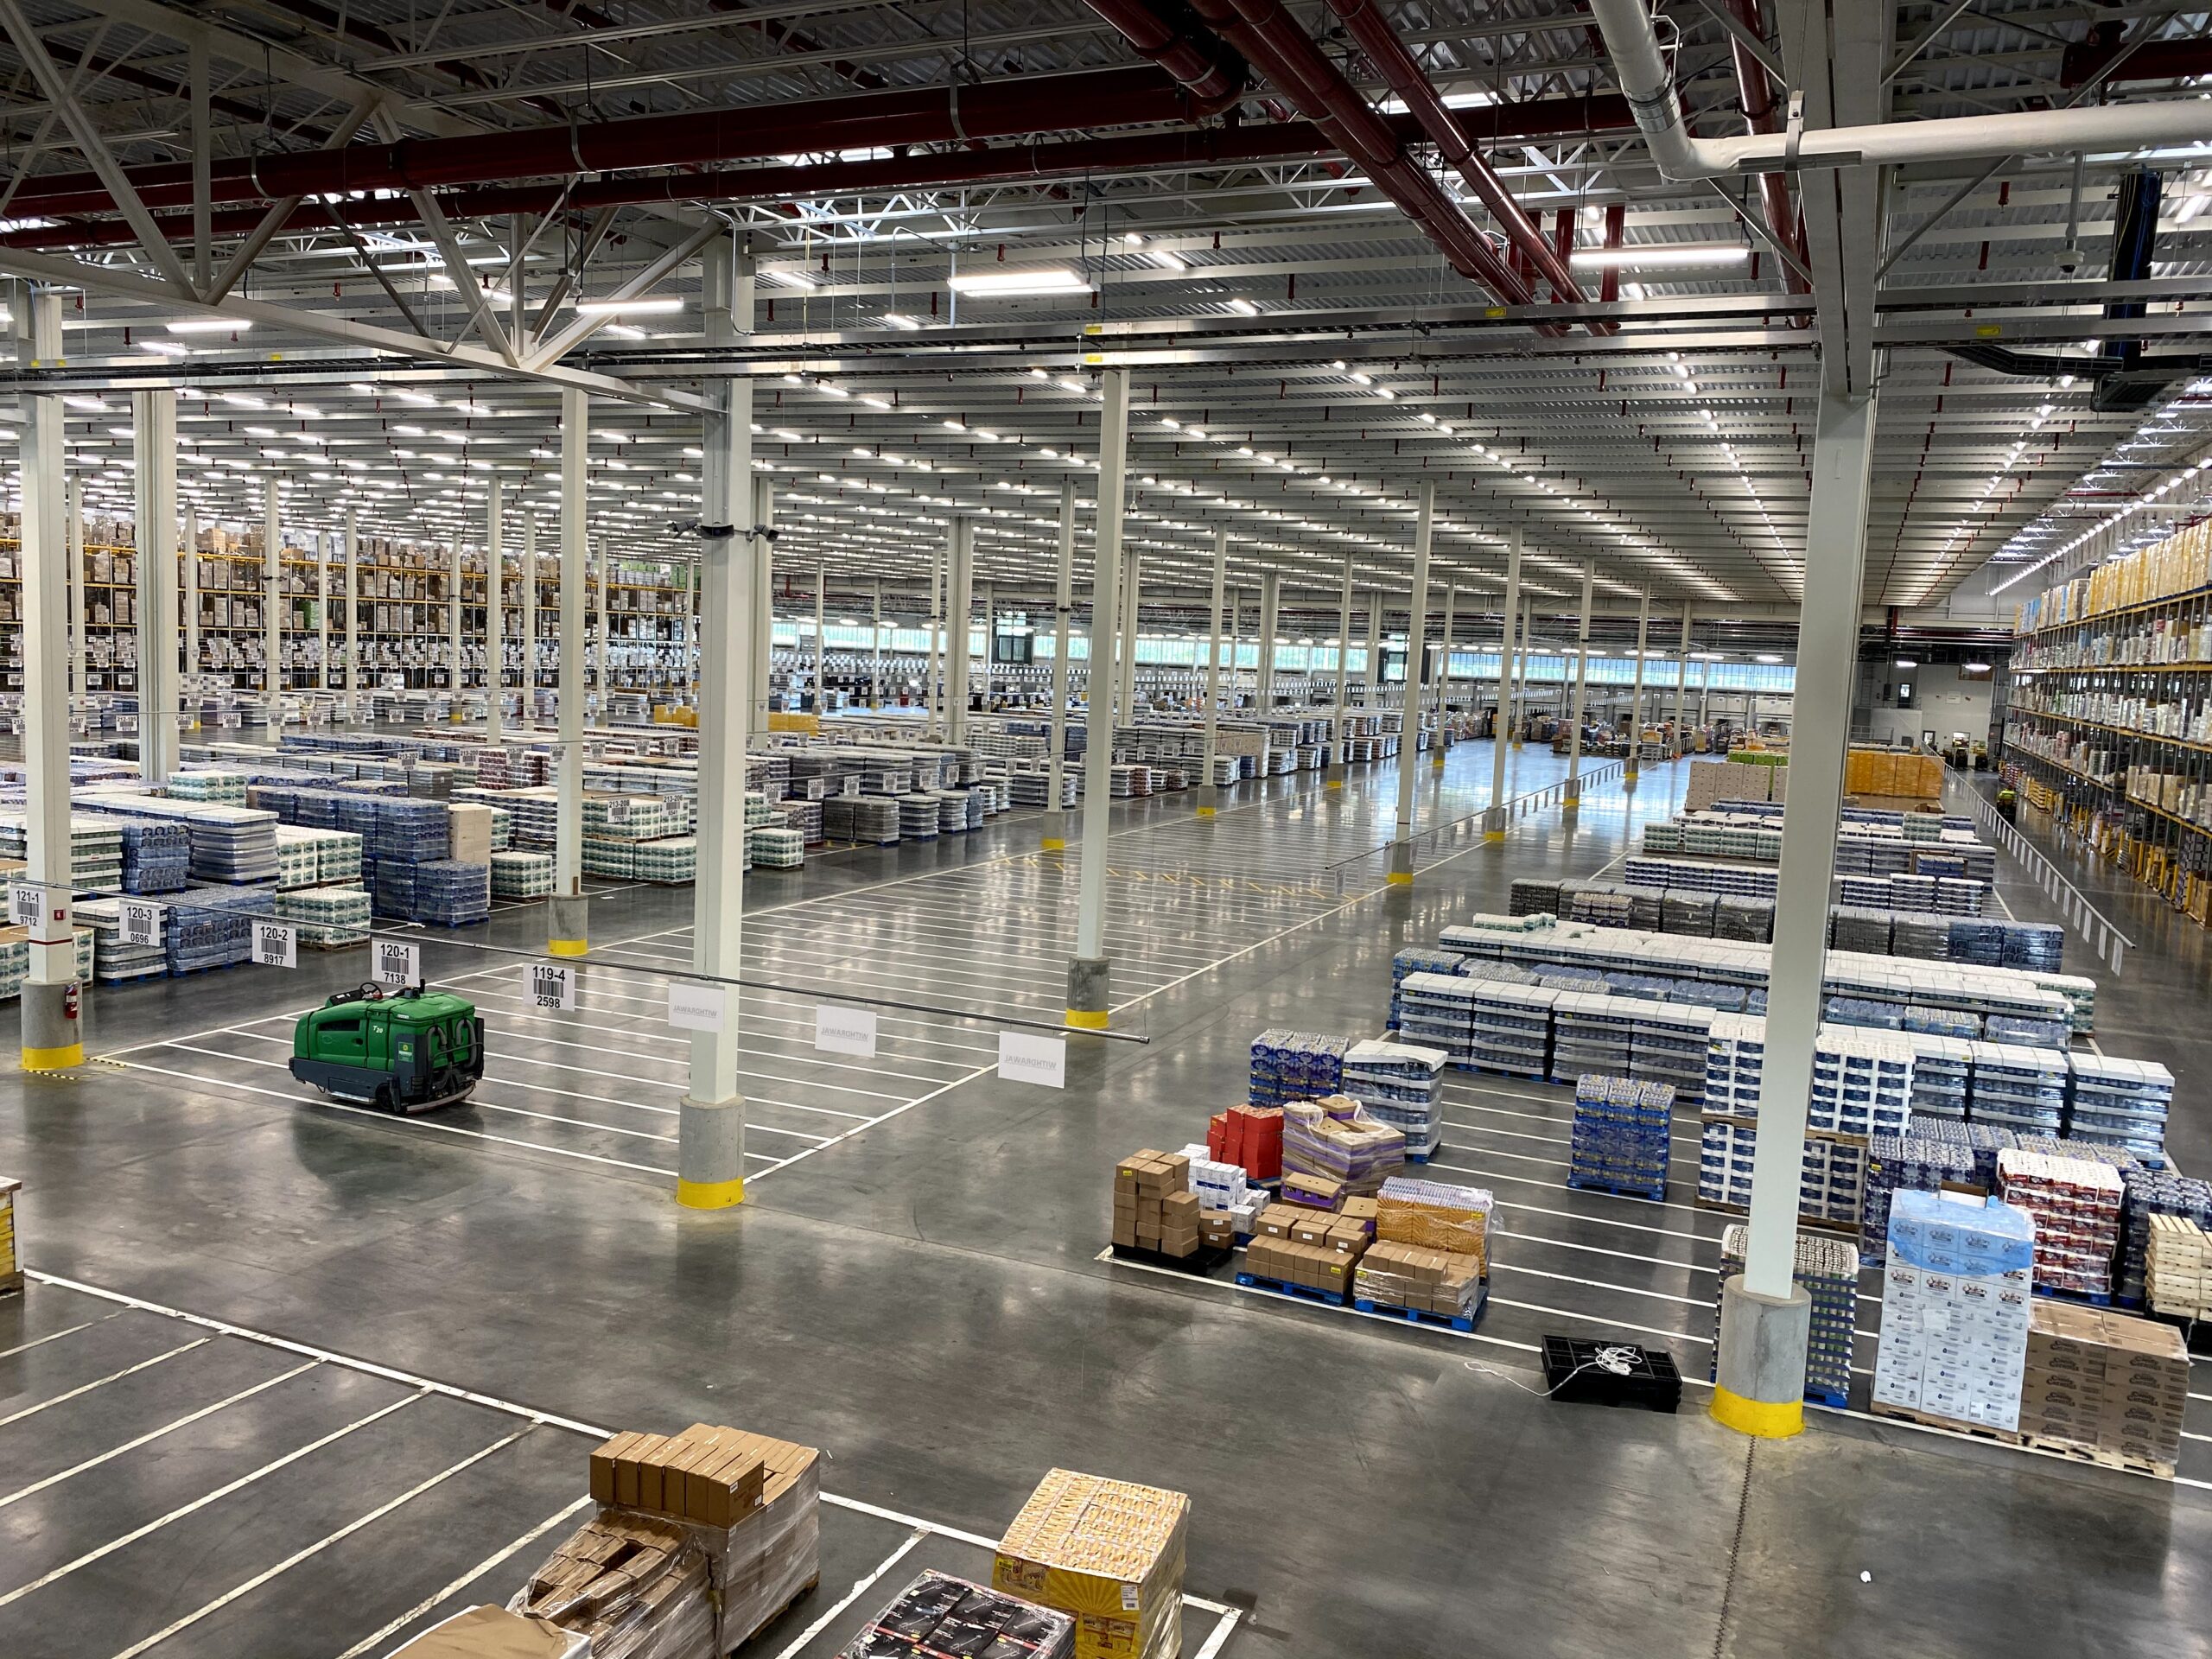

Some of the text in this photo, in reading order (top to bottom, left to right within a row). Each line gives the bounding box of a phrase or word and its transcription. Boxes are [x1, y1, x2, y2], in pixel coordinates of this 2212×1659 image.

[608, 798, 630, 808] 213-208
[664, 794, 683, 803] 213-206
[16, 890, 40, 904] 121-1
[127, 906, 153, 920] 120-3
[19, 915, 37, 926] 9712
[130, 932, 149, 944] 0696
[259, 925, 288, 941] 120-2
[380, 944, 410, 959] 120-1
[264, 953, 284, 965] 8917
[384, 972, 406, 985] 7138
[532, 965, 566, 982] 119-4
[537, 995, 561, 1008] 2598
